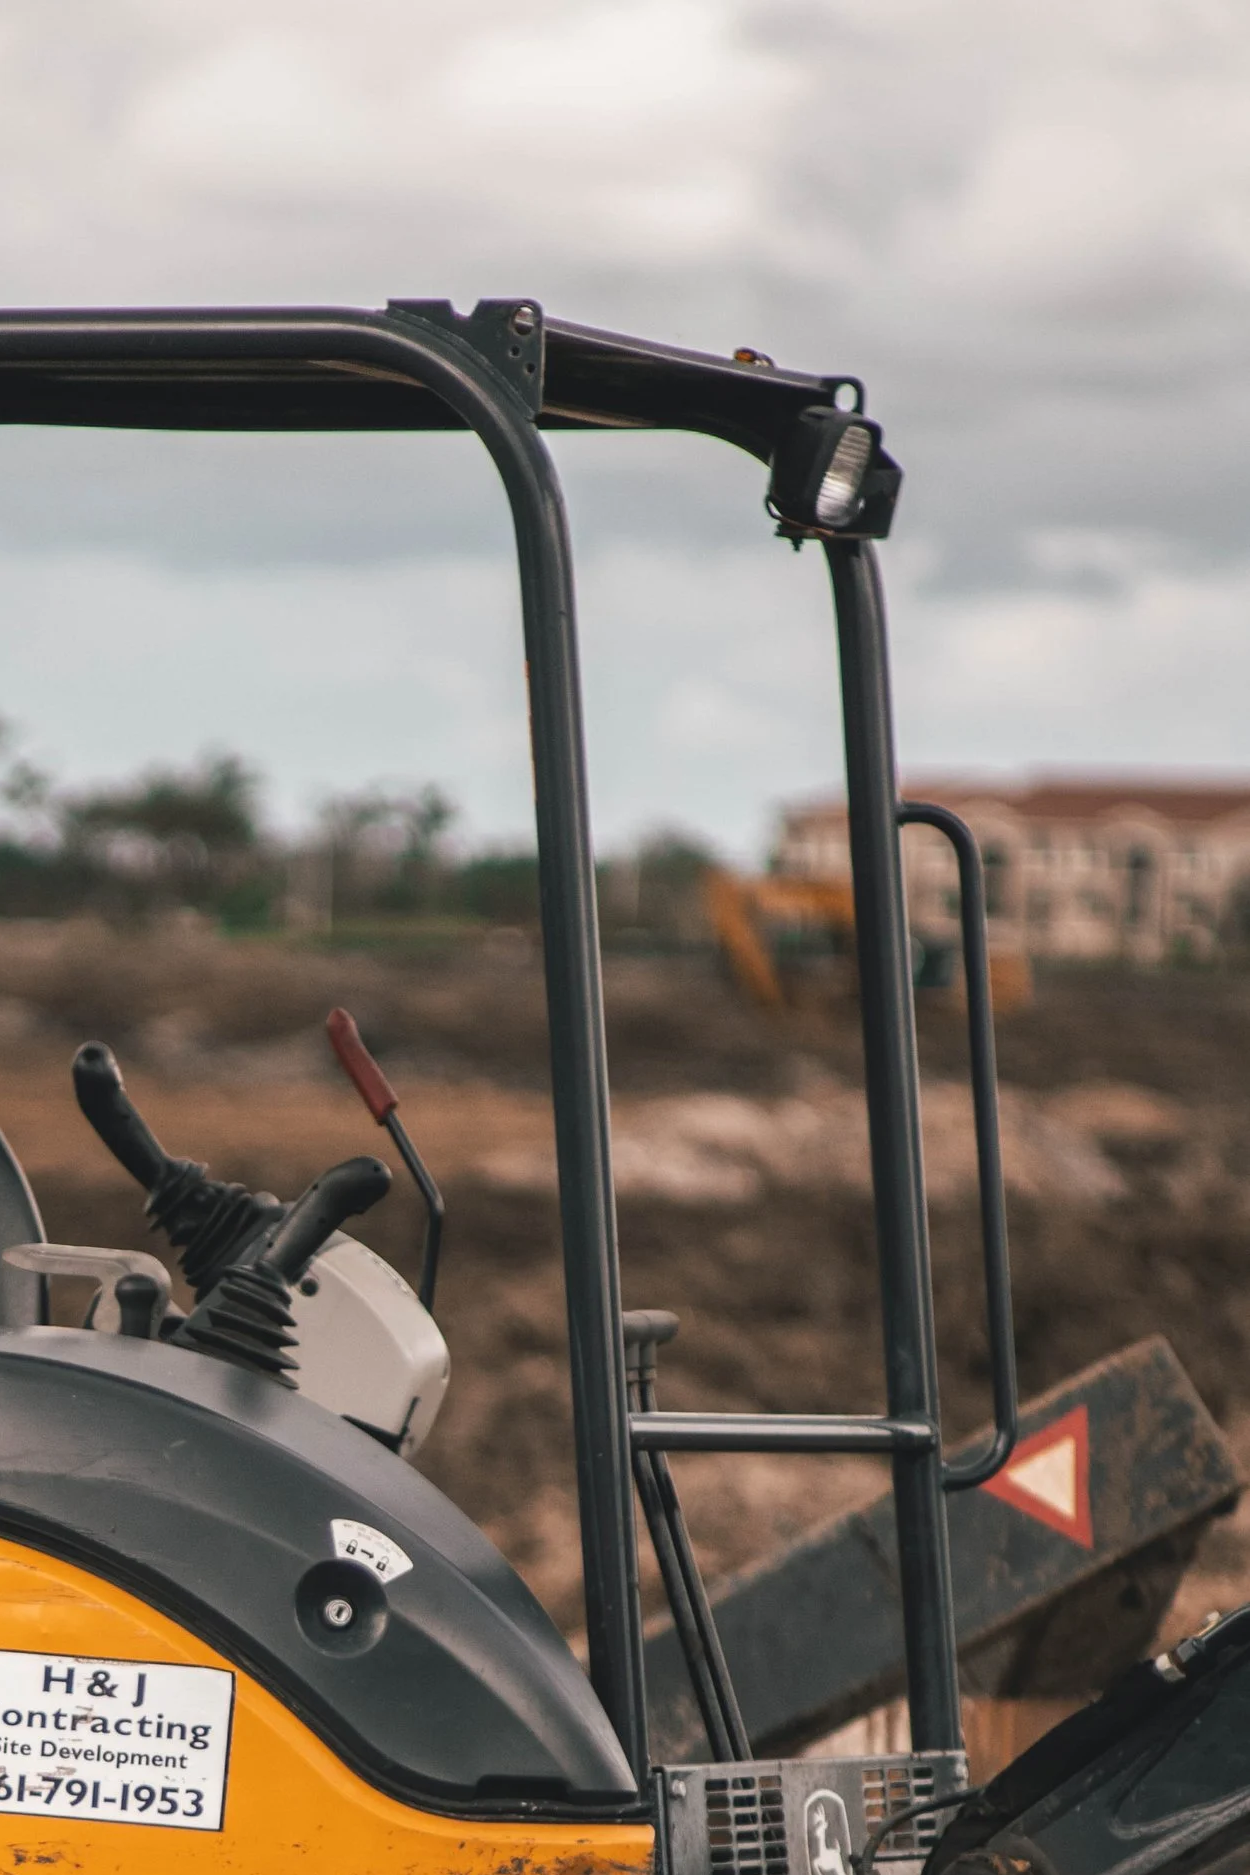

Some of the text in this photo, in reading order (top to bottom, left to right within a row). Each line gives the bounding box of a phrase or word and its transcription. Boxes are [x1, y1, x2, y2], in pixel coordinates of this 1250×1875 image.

[42, 1665, 147, 1707] H & J
[40, 1740, 188, 1769] Development
